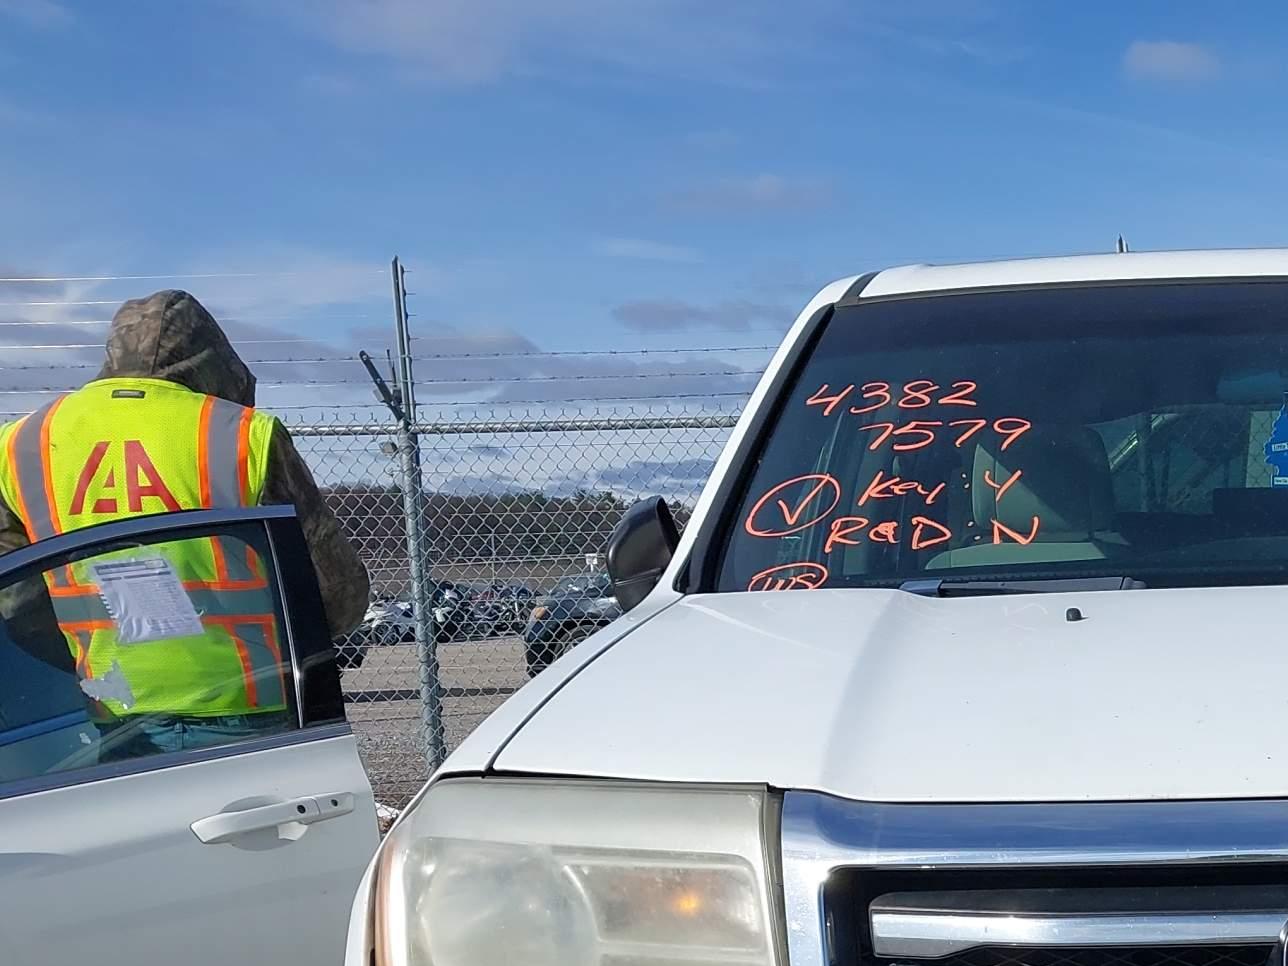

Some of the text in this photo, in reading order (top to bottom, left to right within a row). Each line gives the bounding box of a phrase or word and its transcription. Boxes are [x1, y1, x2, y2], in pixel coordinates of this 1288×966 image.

[806, 380, 978, 416] 4382
[858, 418, 1031, 450] 7579
[991, 516, 1039, 545] N
